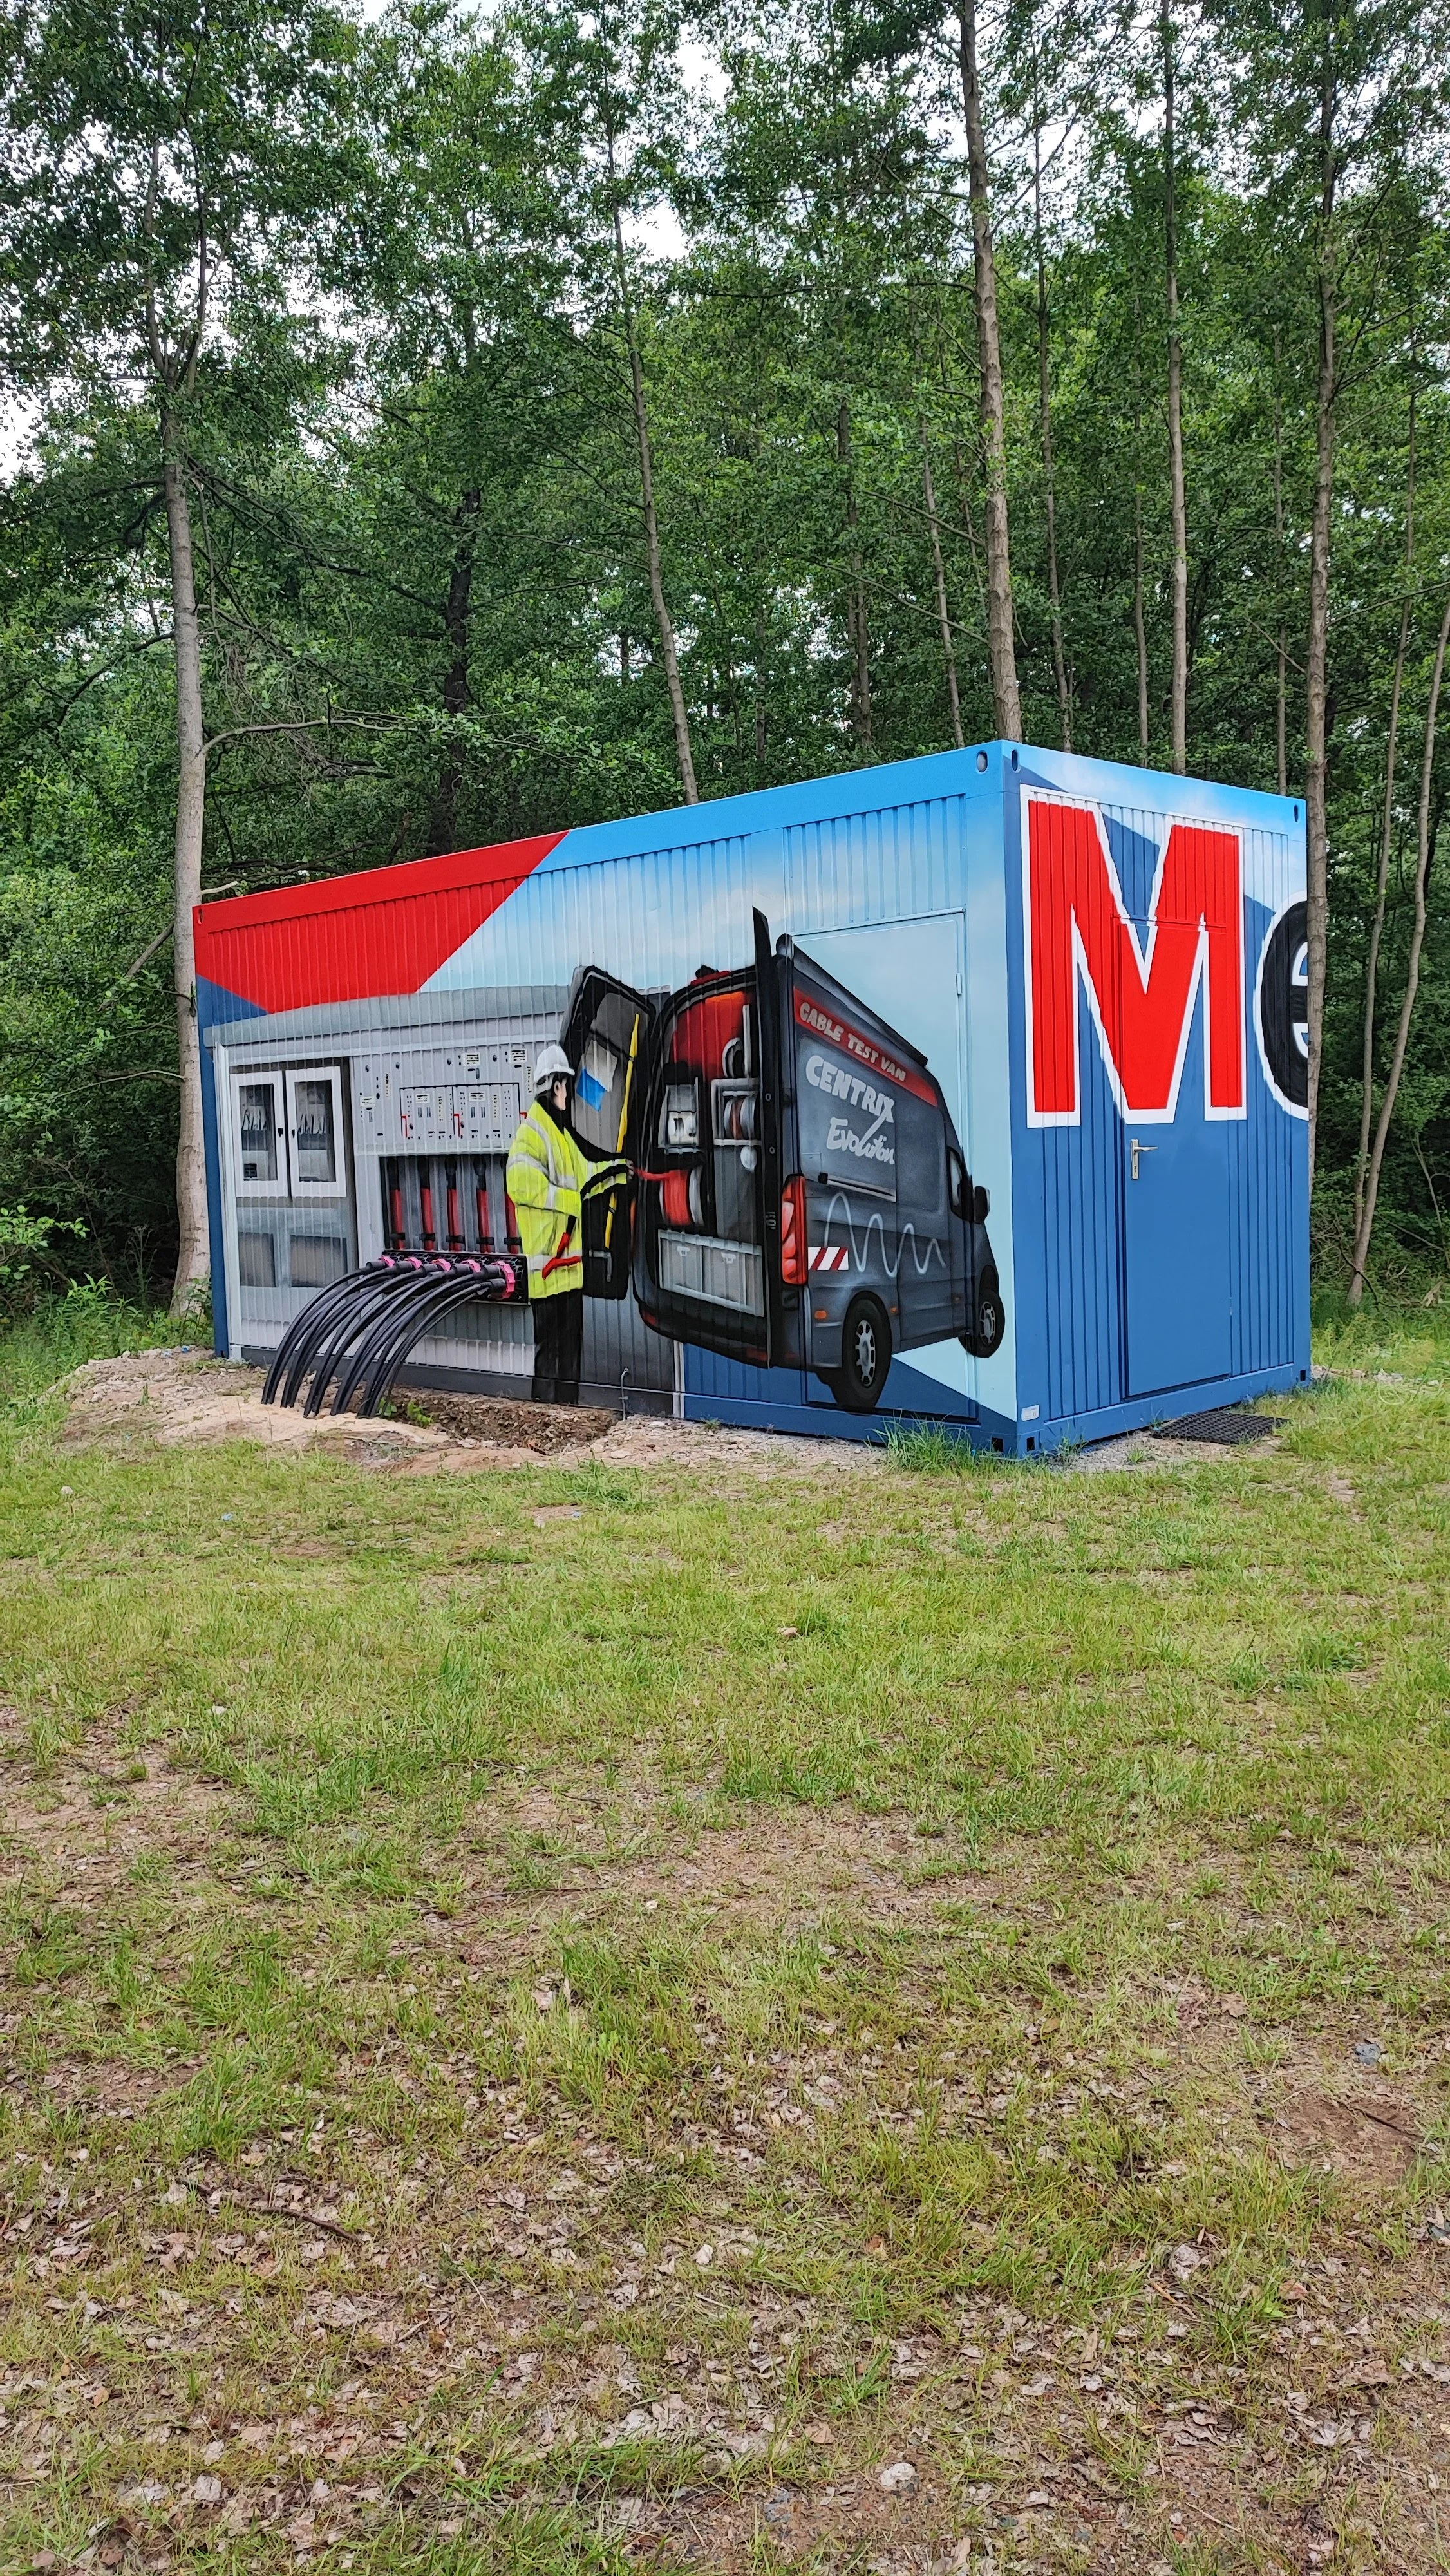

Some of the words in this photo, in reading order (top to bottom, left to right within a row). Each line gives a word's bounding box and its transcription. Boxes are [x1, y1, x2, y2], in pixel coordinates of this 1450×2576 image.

[800, 1002, 844, 1042] CABLE
[847, 1033, 879, 1063] TEST
[881, 1056, 907, 1082] VAN
[806, 1055, 895, 1124] CENTRIX
[826, 1117, 895, 1165] Evolution
